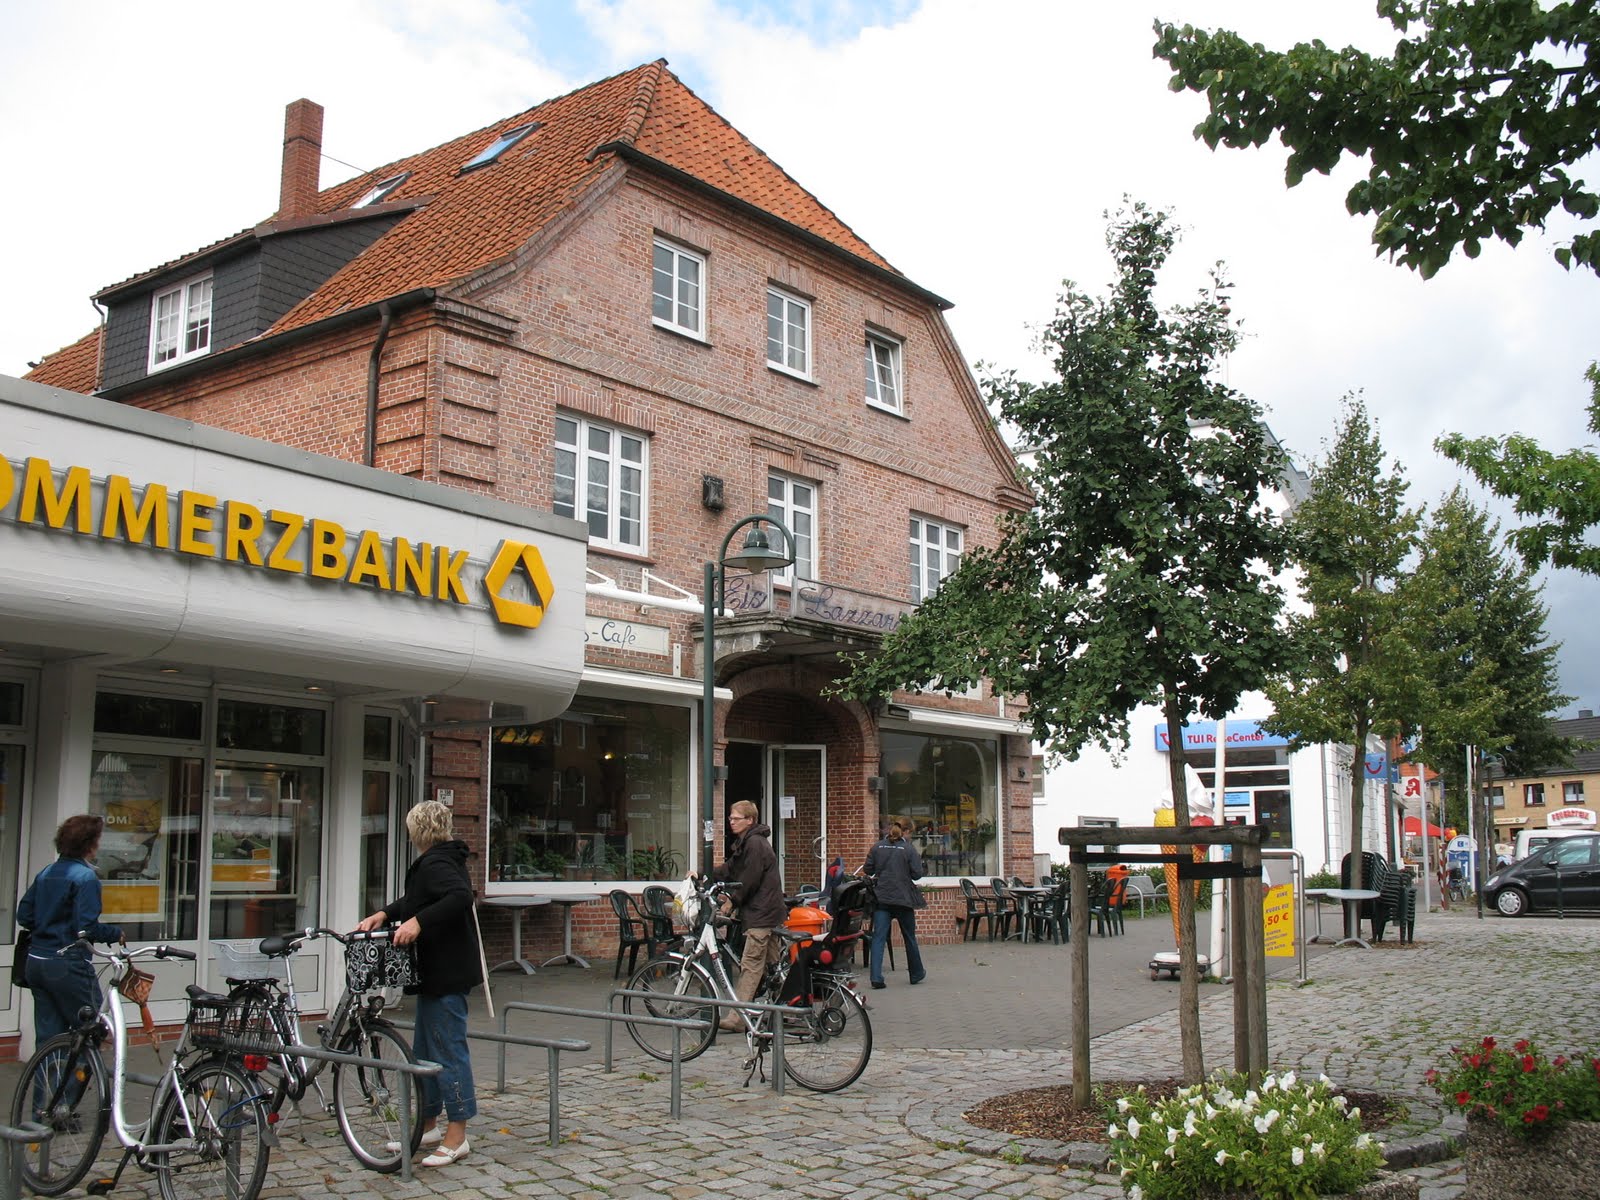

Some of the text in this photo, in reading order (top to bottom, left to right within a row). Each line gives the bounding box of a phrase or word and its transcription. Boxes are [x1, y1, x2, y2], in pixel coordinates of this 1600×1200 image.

[715, 577, 768, 610] Eis
[1187, 732, 1265, 744] TUI ReseCenter
[1264, 912, 1289, 928] ,50 €
